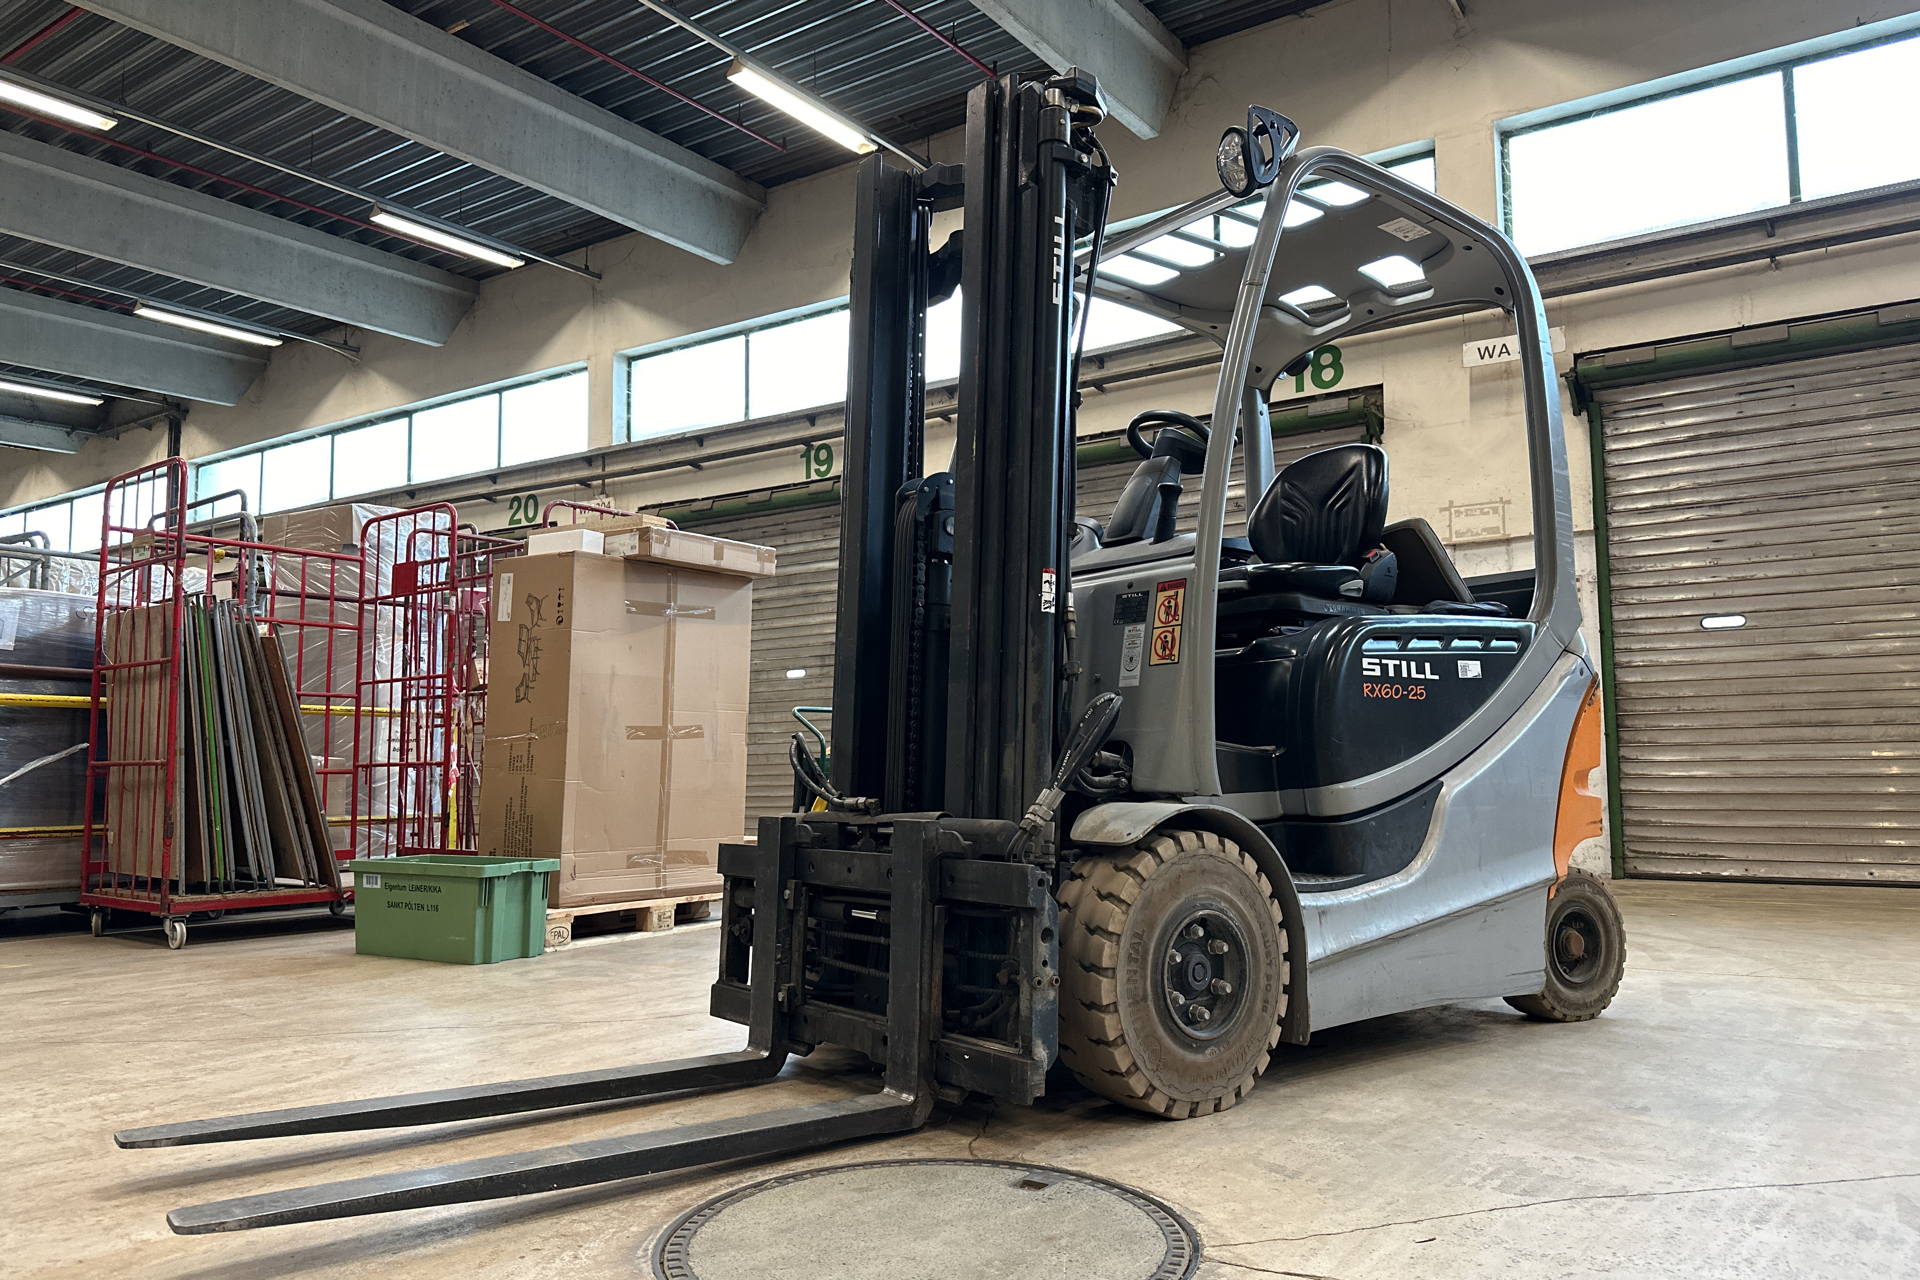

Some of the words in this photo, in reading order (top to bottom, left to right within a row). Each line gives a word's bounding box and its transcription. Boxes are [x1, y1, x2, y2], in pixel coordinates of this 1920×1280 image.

[1477, 343, 1511, 360] WA
[800, 443, 834, 480] 19
[508, 493, 539, 526] 20
[1361, 657, 1440, 680] STILL
[1363, 682, 1426, 700] RX60-25
[384, 882, 407, 892] Eigentum
[386, 900, 404, 910] SANKT
[404, 900, 425, 911] PÖLTEN
